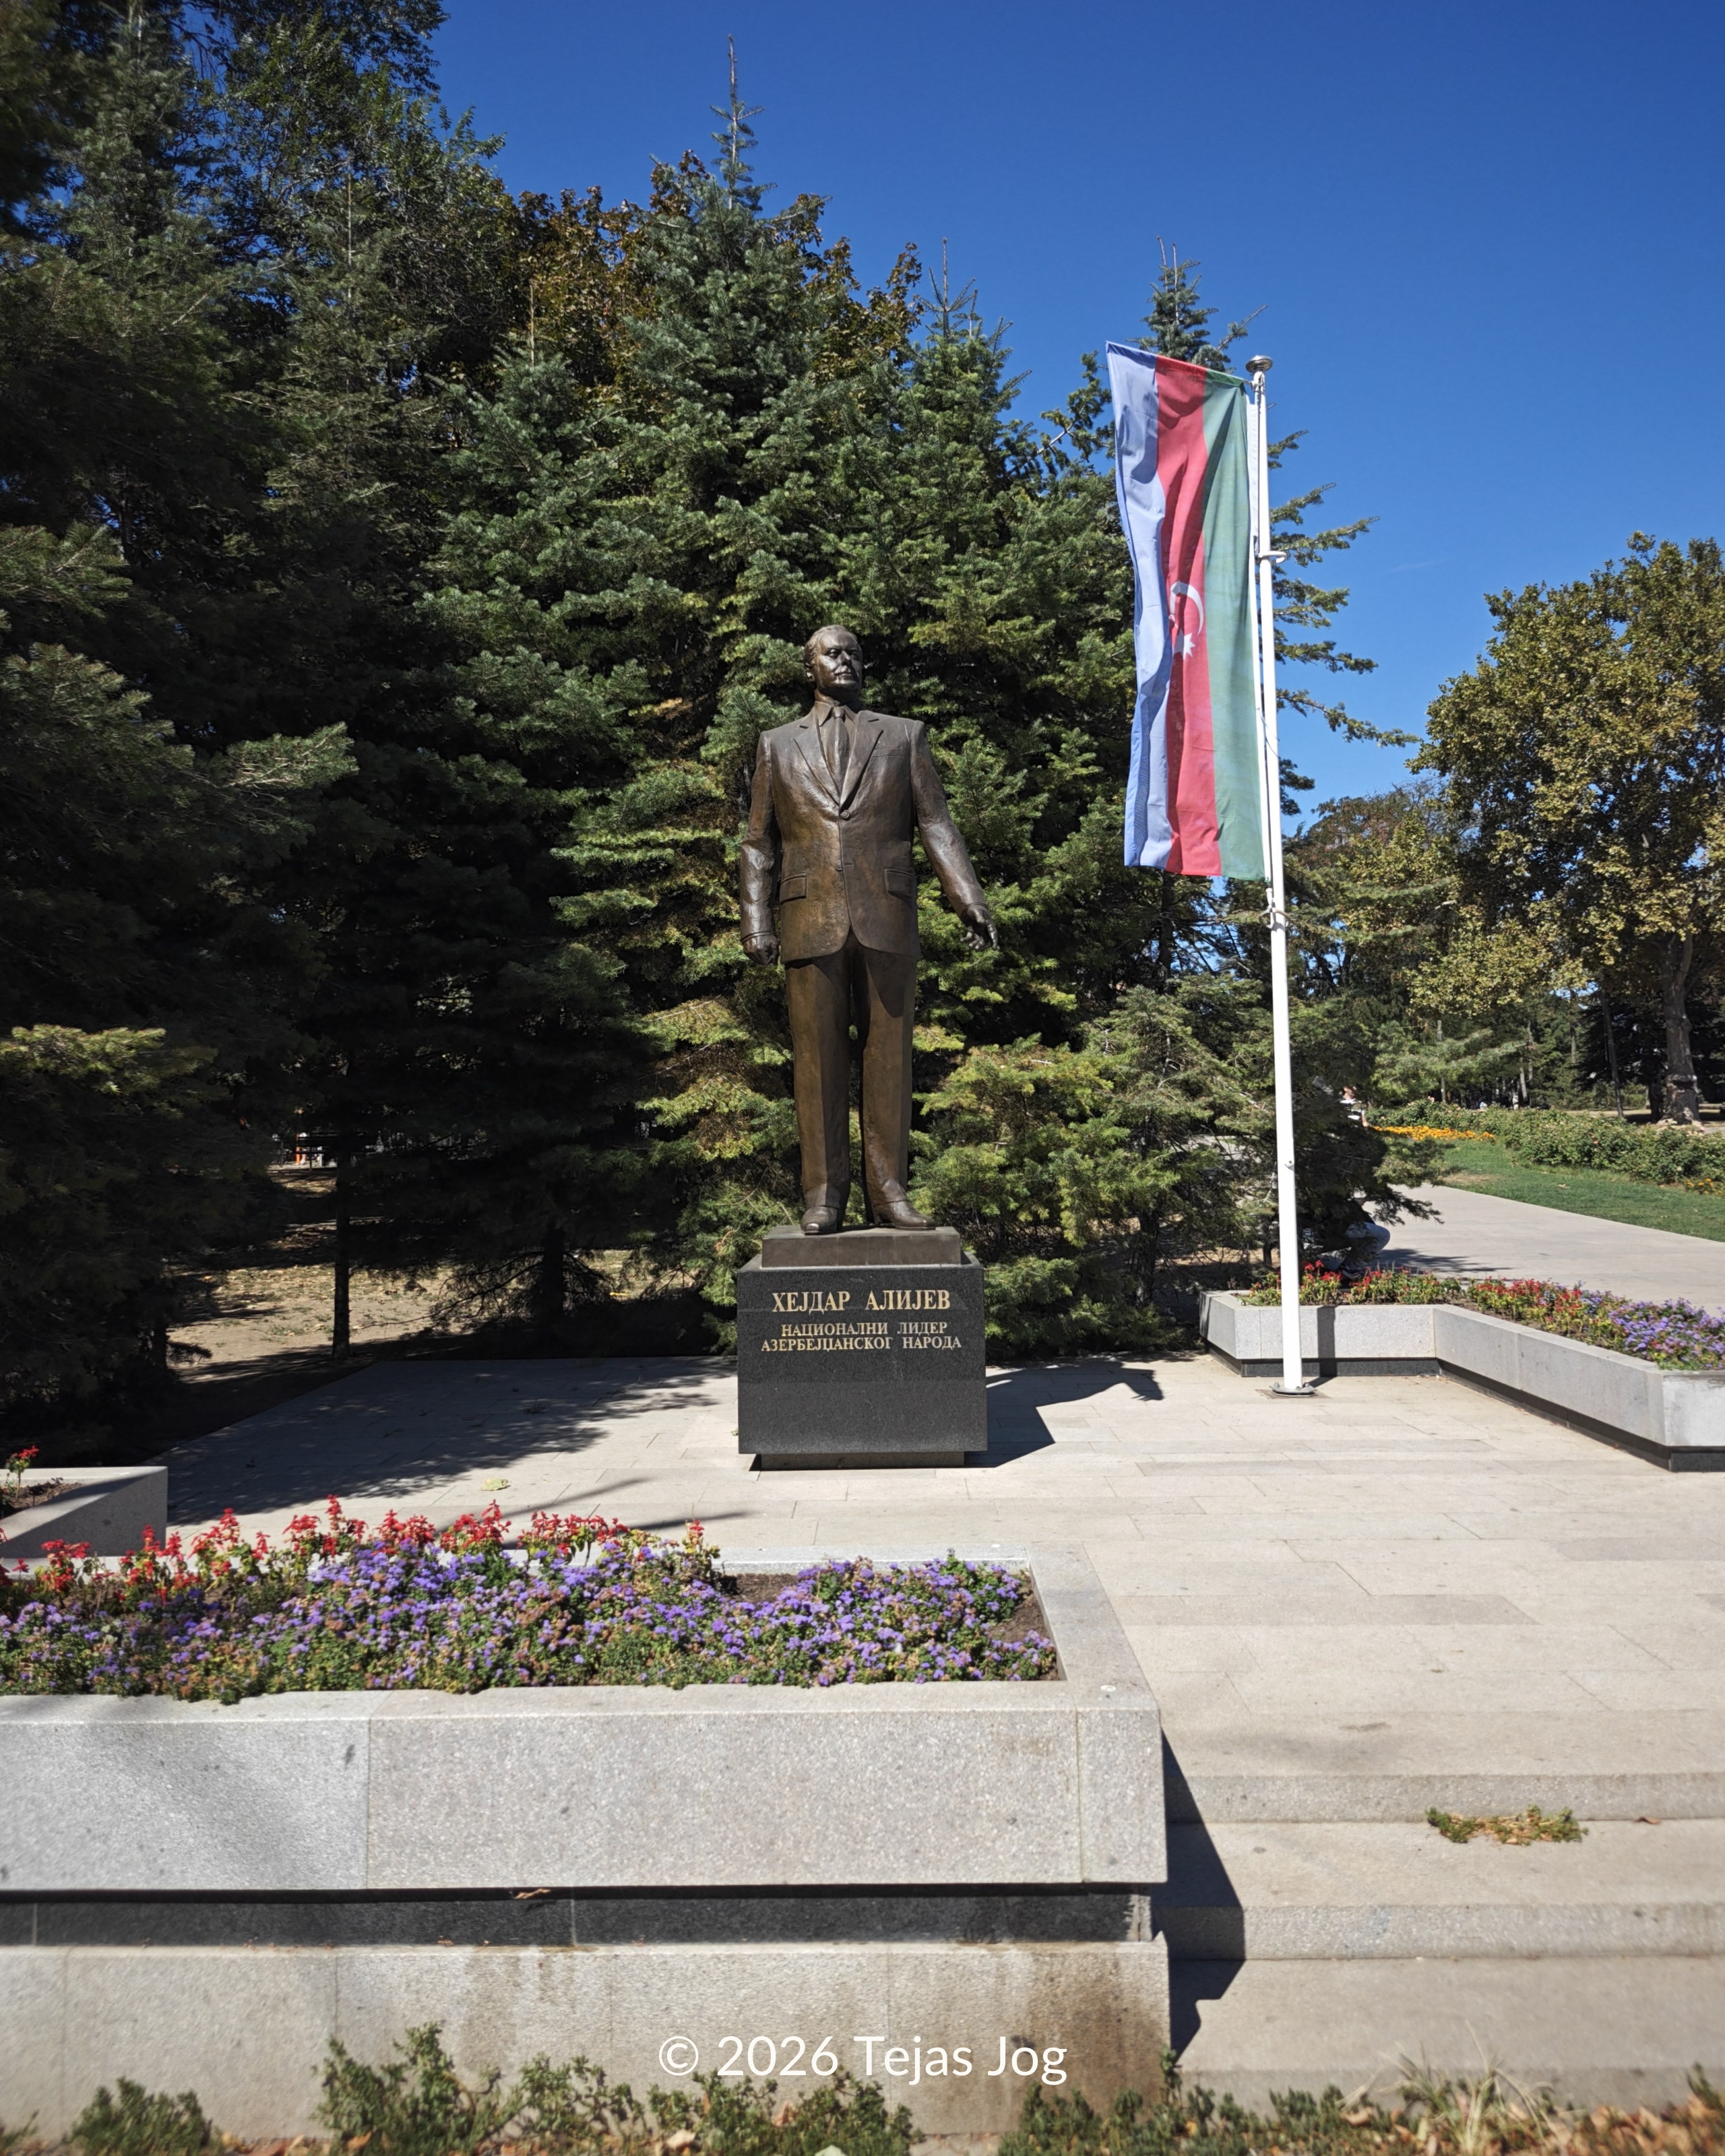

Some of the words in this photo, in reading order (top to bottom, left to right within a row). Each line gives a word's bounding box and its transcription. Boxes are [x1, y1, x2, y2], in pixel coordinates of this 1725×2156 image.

[772, 1291, 850, 1315] ХЕЈДАР
[865, 1290, 951, 1310] АЛИЈЕВ
[781, 1323, 888, 1337] НАЦИОНАЛНИ
[897, 1322, 947, 1336] ЛИДЕР
[761, 1337, 893, 1352] АЗЕРБЕЈЏАНСКОГ
[902, 1336, 962, 1351] НАРОДА
